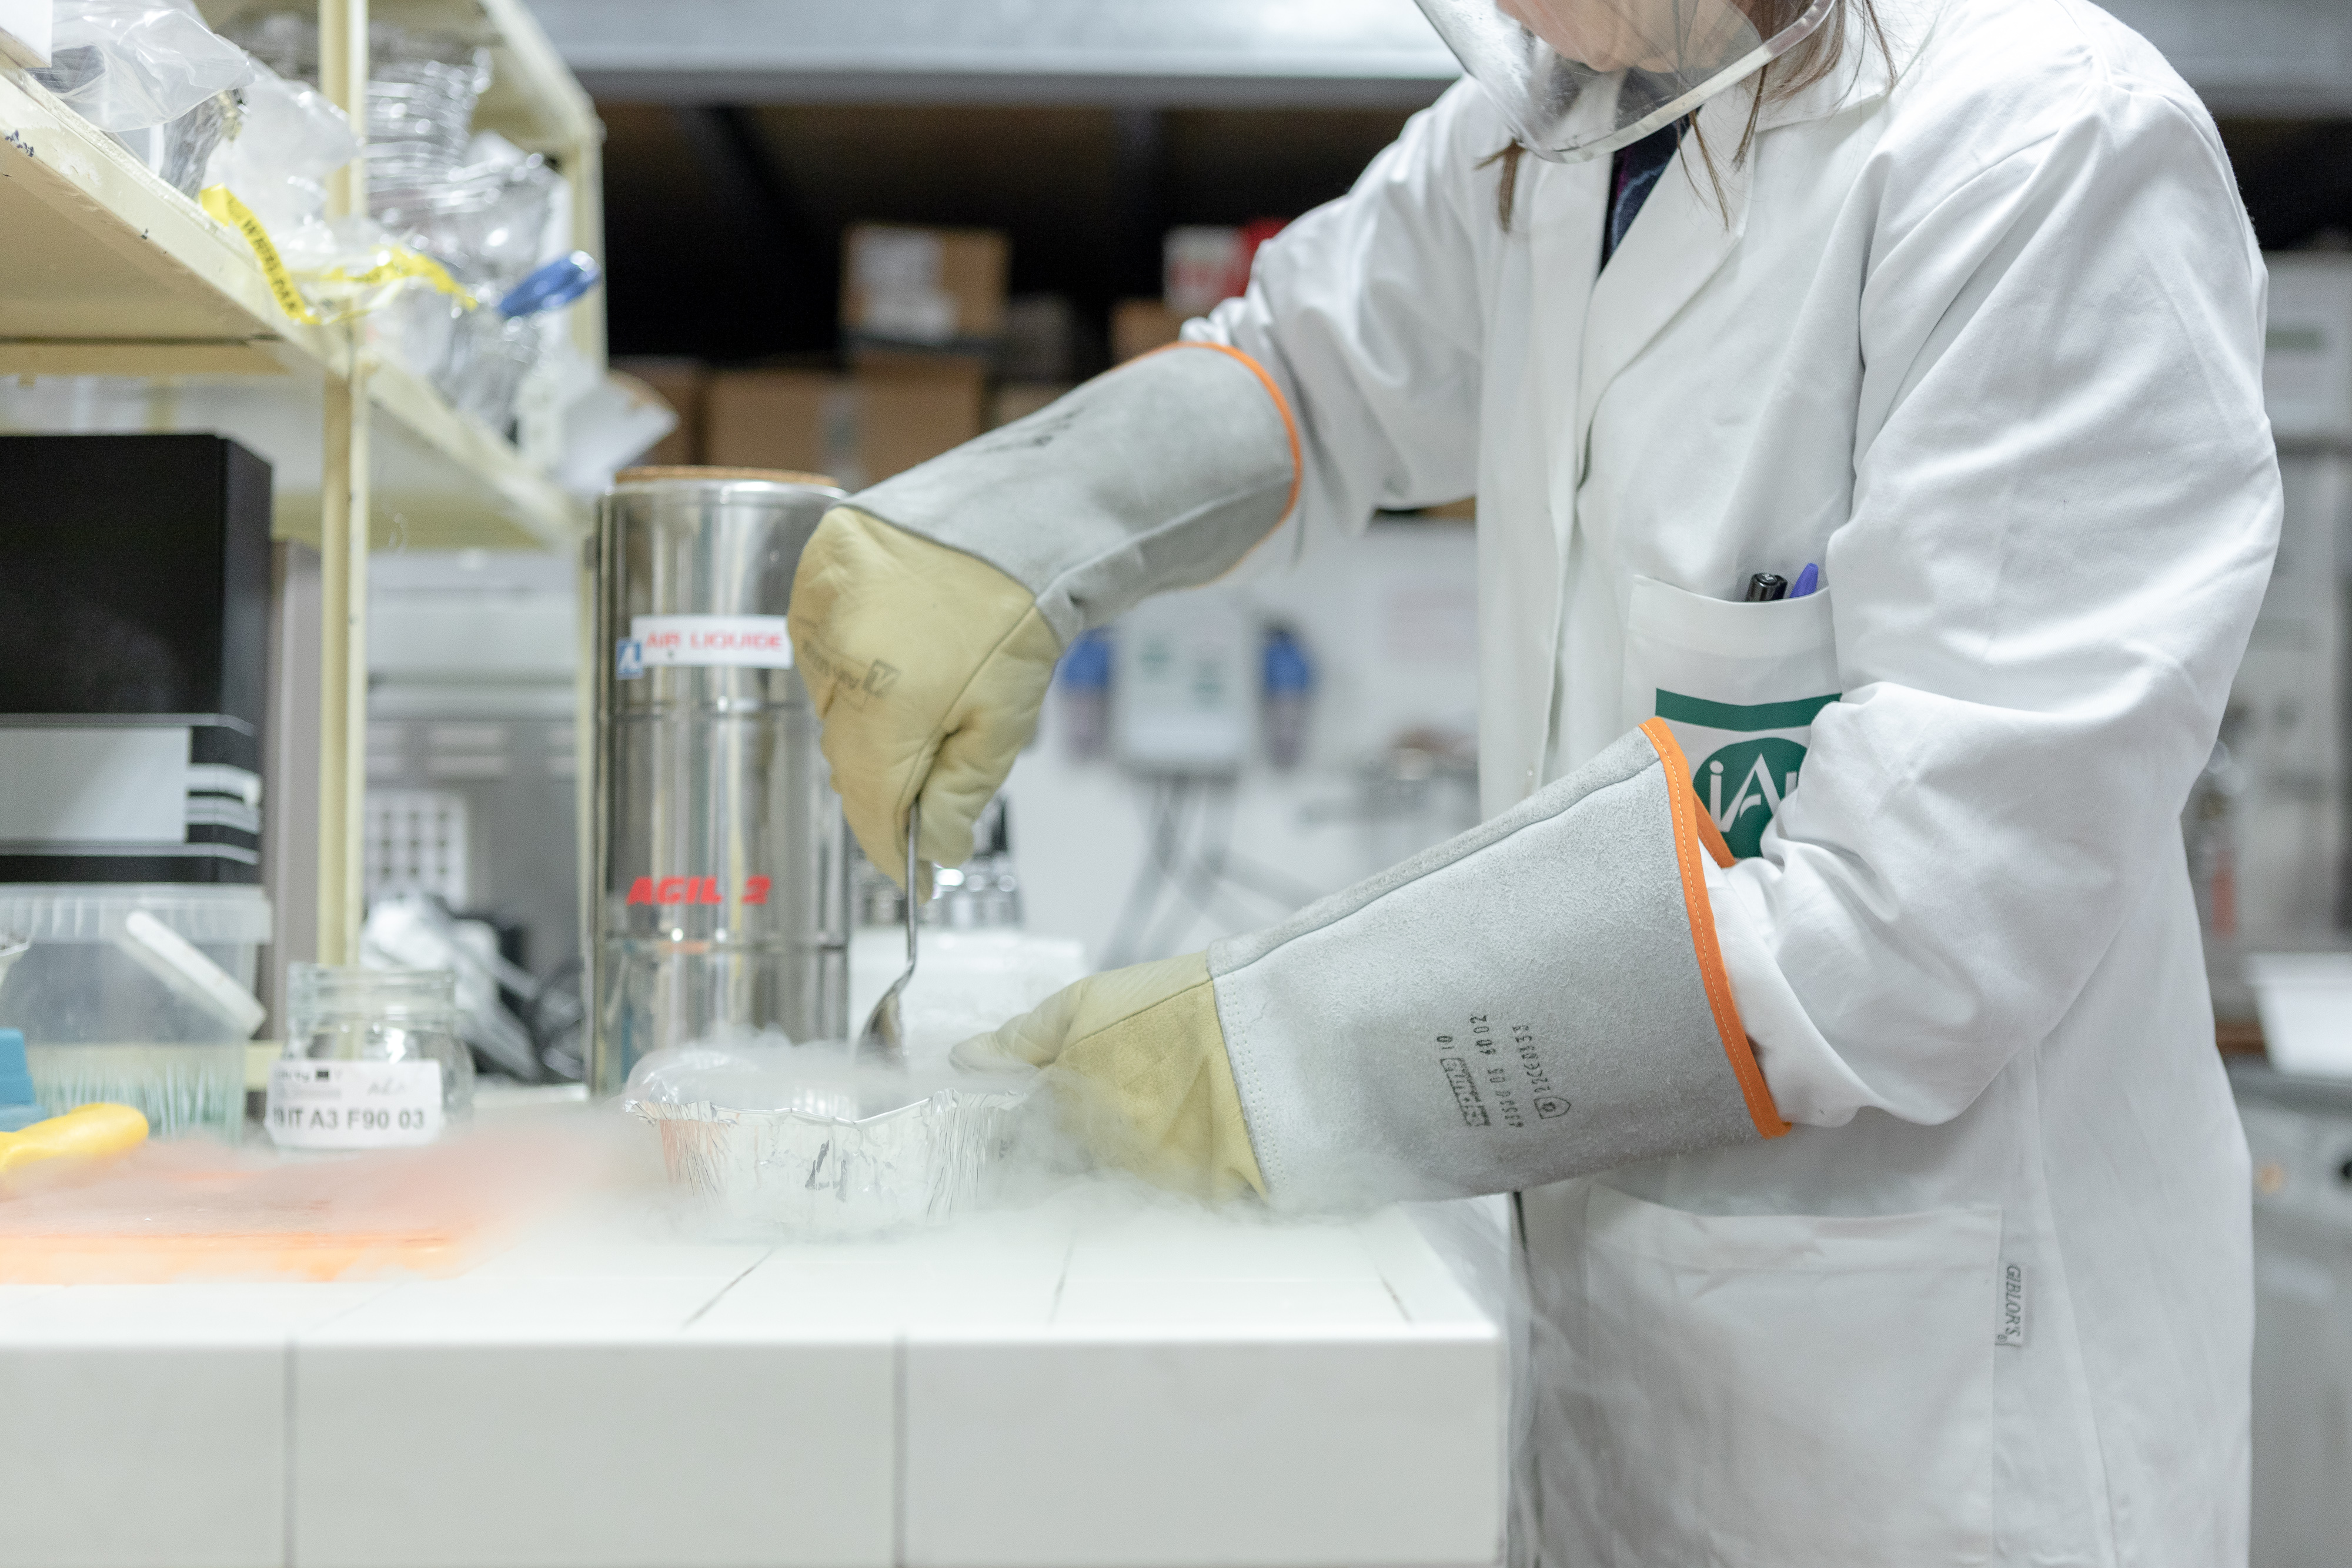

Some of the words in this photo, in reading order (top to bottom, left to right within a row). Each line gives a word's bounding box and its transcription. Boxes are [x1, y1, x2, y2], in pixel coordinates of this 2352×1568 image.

[647, 630, 681, 647] AIR
[690, 631, 782, 651] LIQUIDE
[626, 875, 722, 905] AGIL
[309, 1108, 338, 1129] A3
[348, 1108, 390, 1129] F90
[398, 1108, 425, 1129] 03
